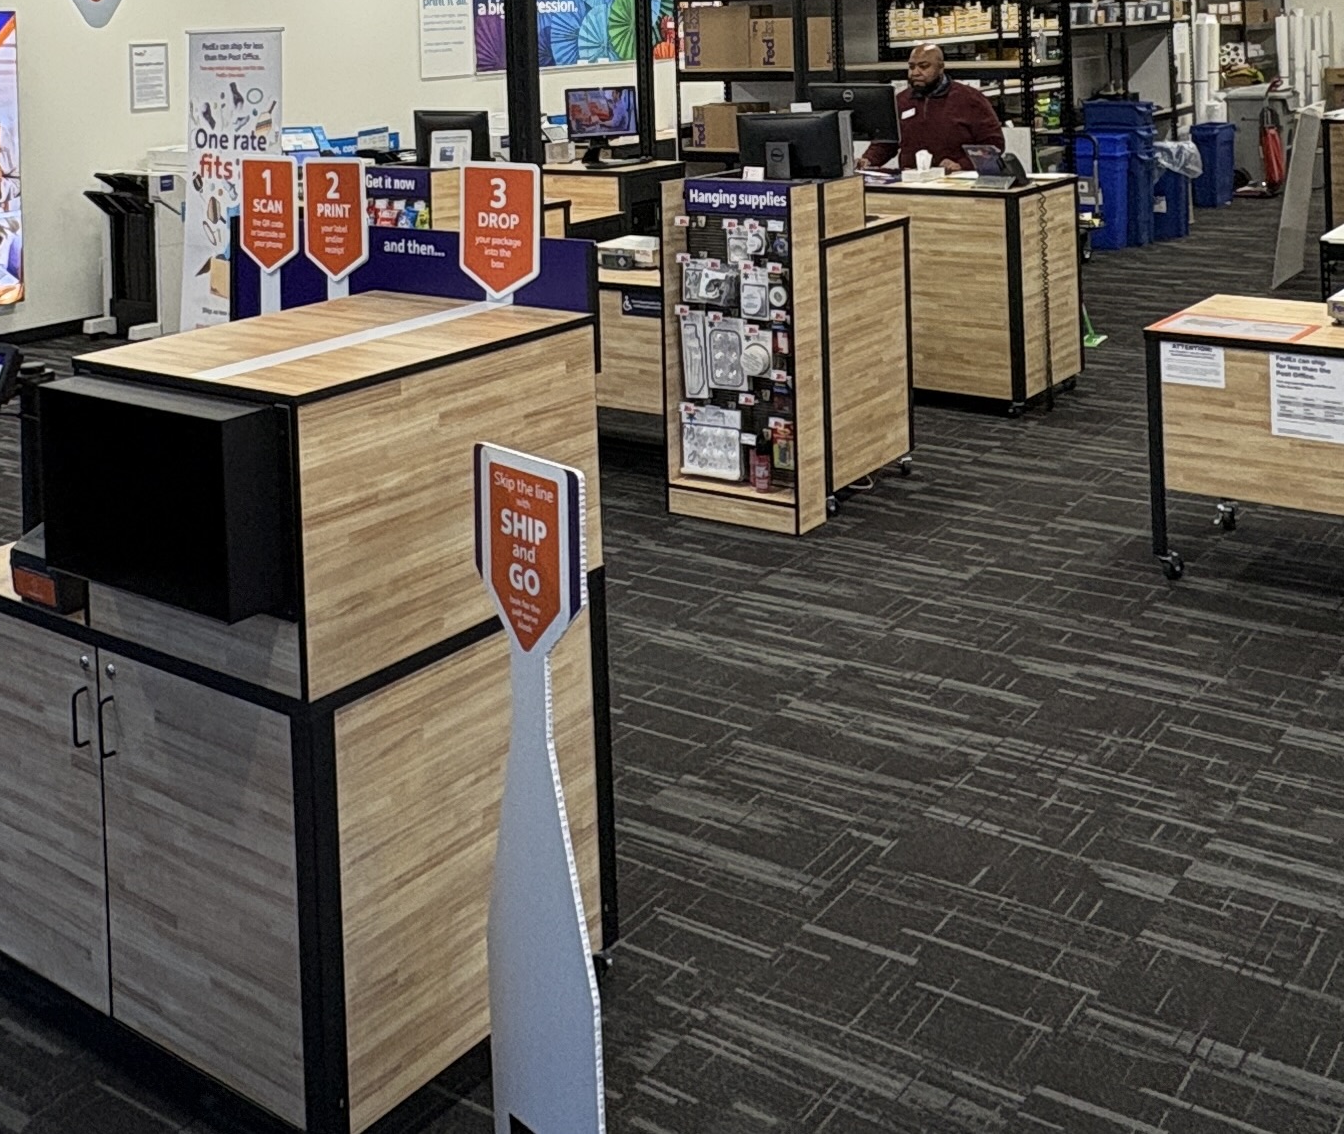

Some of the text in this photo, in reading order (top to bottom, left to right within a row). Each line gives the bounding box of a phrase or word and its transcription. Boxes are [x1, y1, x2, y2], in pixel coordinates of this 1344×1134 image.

[478, 3, 486, 16] a
[686, 7, 701, 66] FedEx
[195, 128, 267, 151] One rate
[199, 152, 233, 180] fits
[262, 169, 271, 195] 1
[326, 171, 340, 199] 2
[366, 174, 415, 190] Get it now
[490, 177, 507, 209] 3
[252, 199, 283, 214] SCAN
[317, 203, 351, 218] PRINT
[689, 189, 787, 209] Hanging supplies
[478, 212, 520, 230] DROP
[384, 239, 445, 257] and then...
[494, 470, 554, 503] Skip the line
[500, 508, 547, 545] SHIP
[512, 543, 535, 564] and
[509, 562, 540, 596] GO
